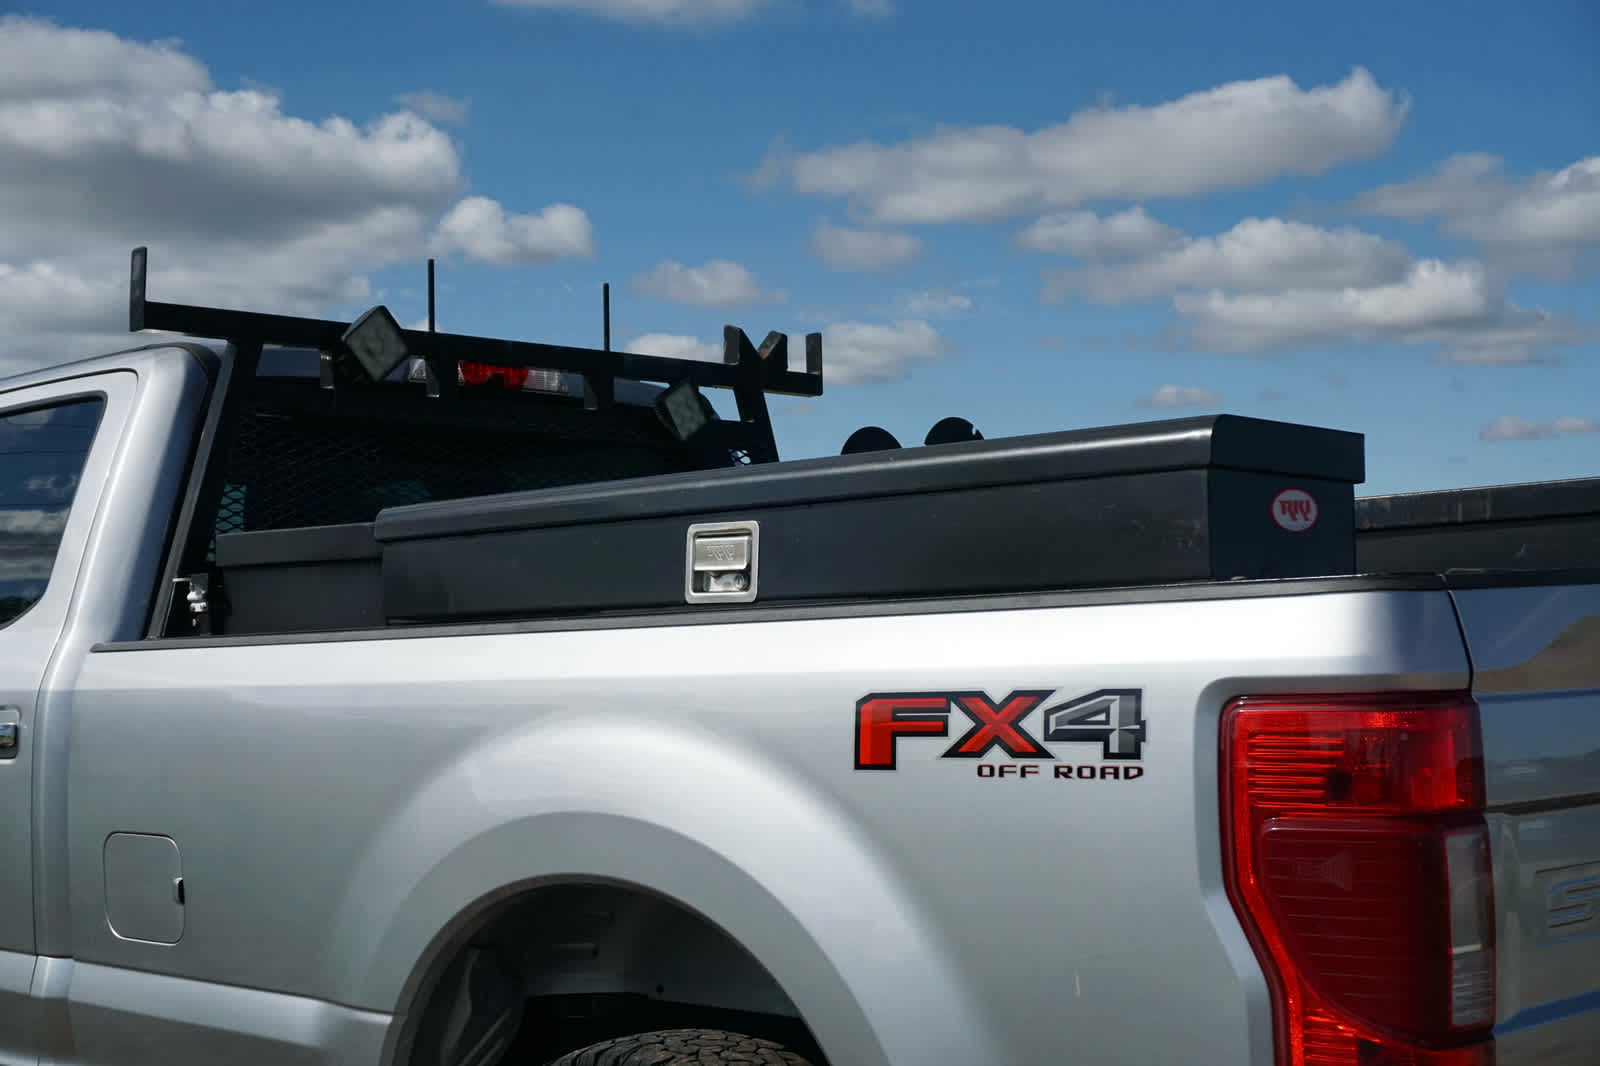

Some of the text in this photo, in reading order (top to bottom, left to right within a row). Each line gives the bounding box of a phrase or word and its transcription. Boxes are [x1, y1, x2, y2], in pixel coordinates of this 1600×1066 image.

[854, 688, 1146, 770] FX4
[977, 764, 1144, 780] OFF ROAD
